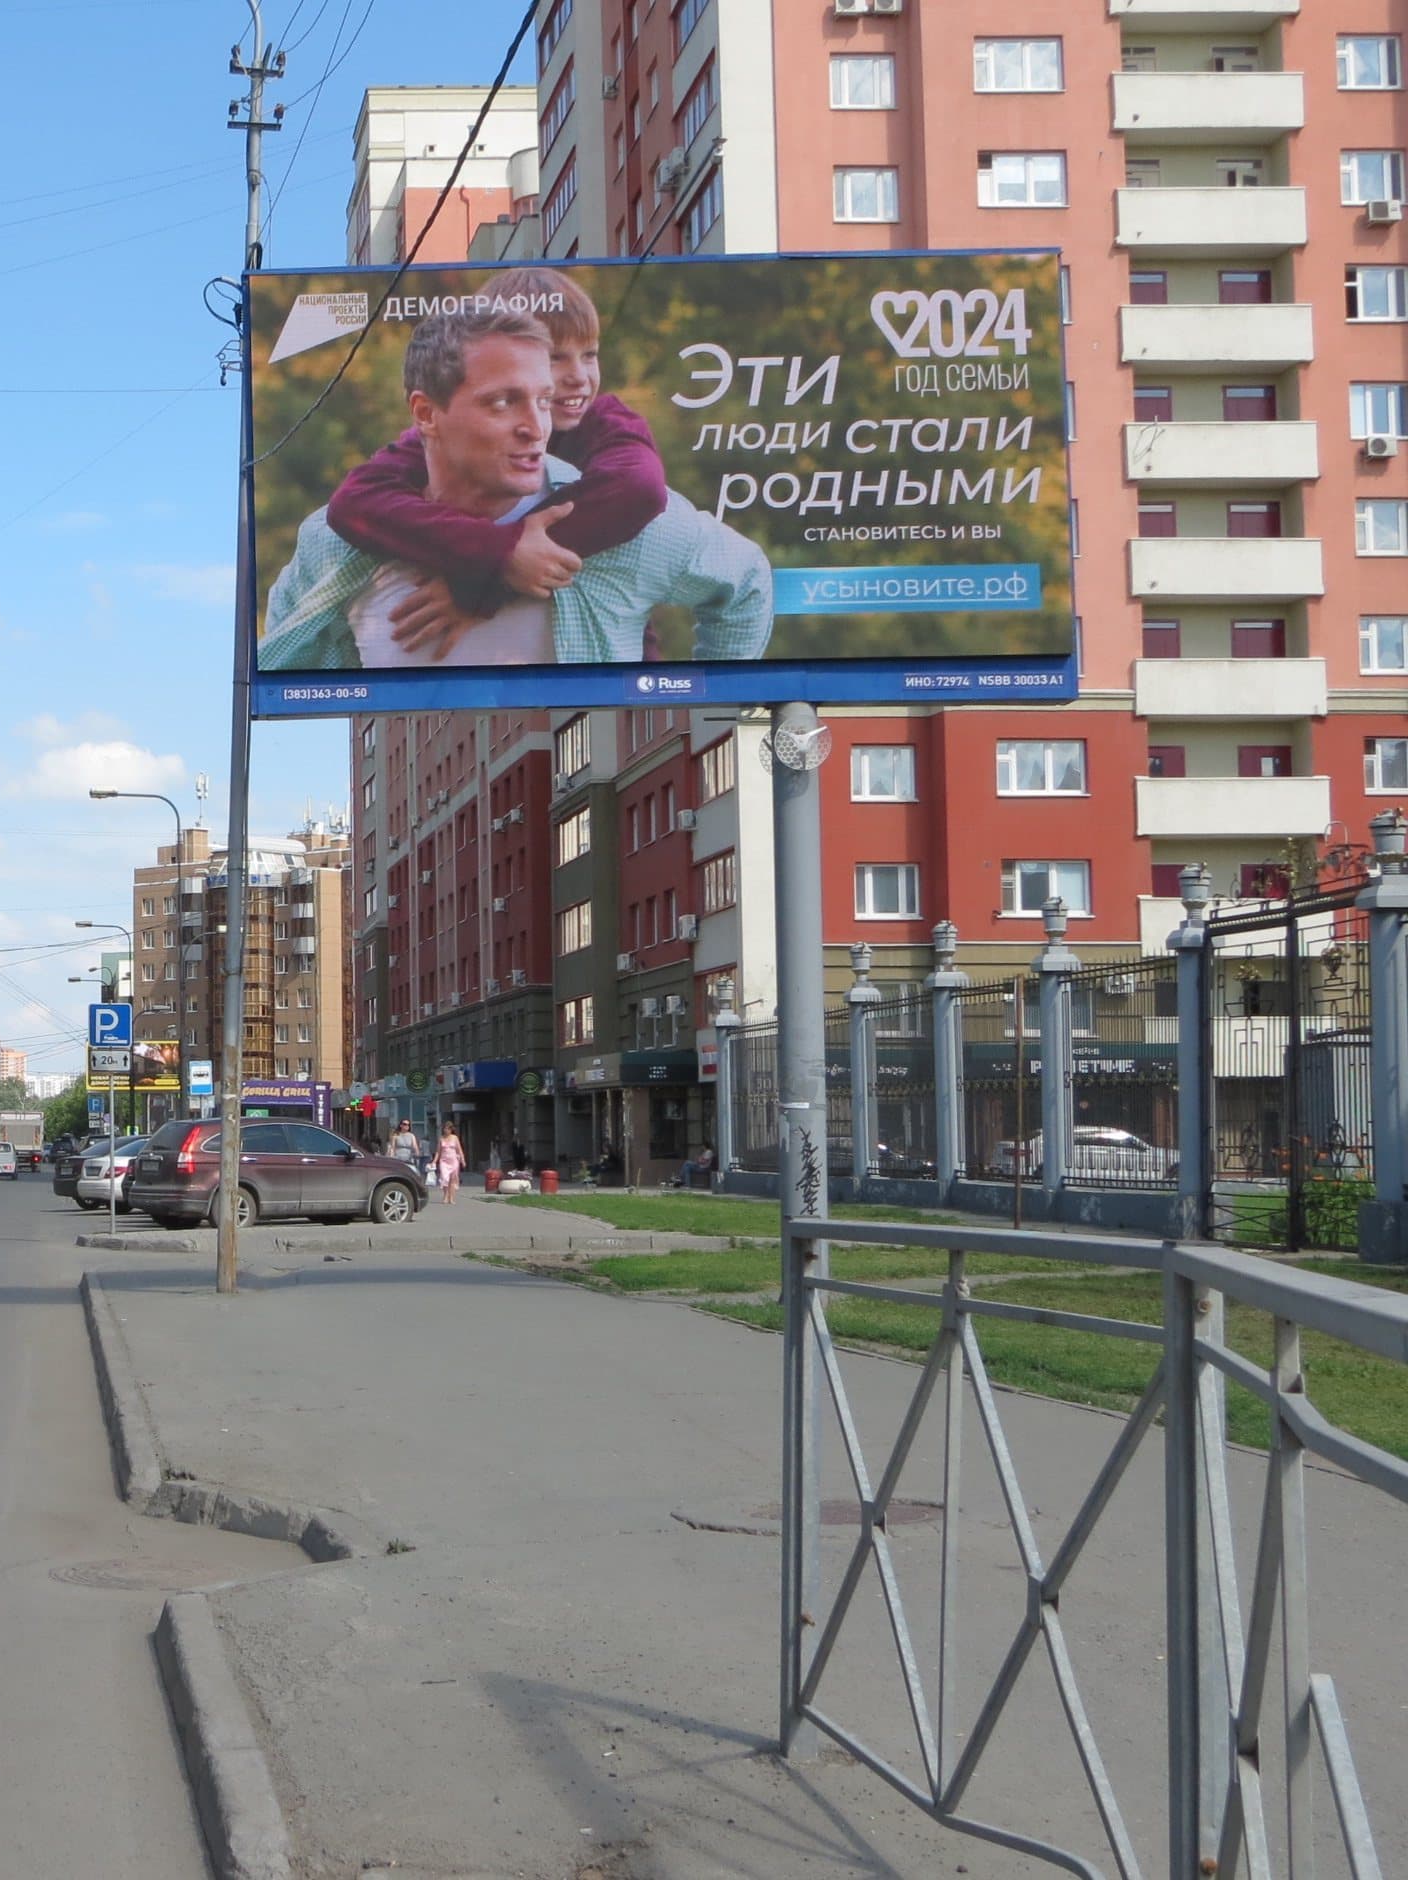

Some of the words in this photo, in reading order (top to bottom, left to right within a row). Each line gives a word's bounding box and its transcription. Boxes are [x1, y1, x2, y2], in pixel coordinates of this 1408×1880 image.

[298, 293, 368, 305] НАЦИОНАЛЬНЫЕ
[383, 292, 564, 321] ДЕМОГРАФИЯ
[327, 304, 368, 315] ПРОЕКТЫ
[335, 315, 368, 325] РОССИИ
[888, 288, 1033, 358] 2024
[670, 342, 841, 409] Эти
[692, 421, 832, 455] люди
[845, 416, 1034, 454] стали
[715, 466, 1042, 522] родными
[803, 525, 947, 541] СТАНОВИТЕСЬ
[951, 526, 966, 540] И
[971, 525, 1002, 539] ВЫ
[802, 572, 1028, 602] усыновите.рф
[658, 677, 692, 689] Russ
[978, 675, 1011, 686] NSBB
[1014, 675, 1048, 685] 30033
[283, 687, 368, 700] (383)363-00-50
[95, 1009, 119, 1043] P
[282, 1087, 311, 1097] GRILL
